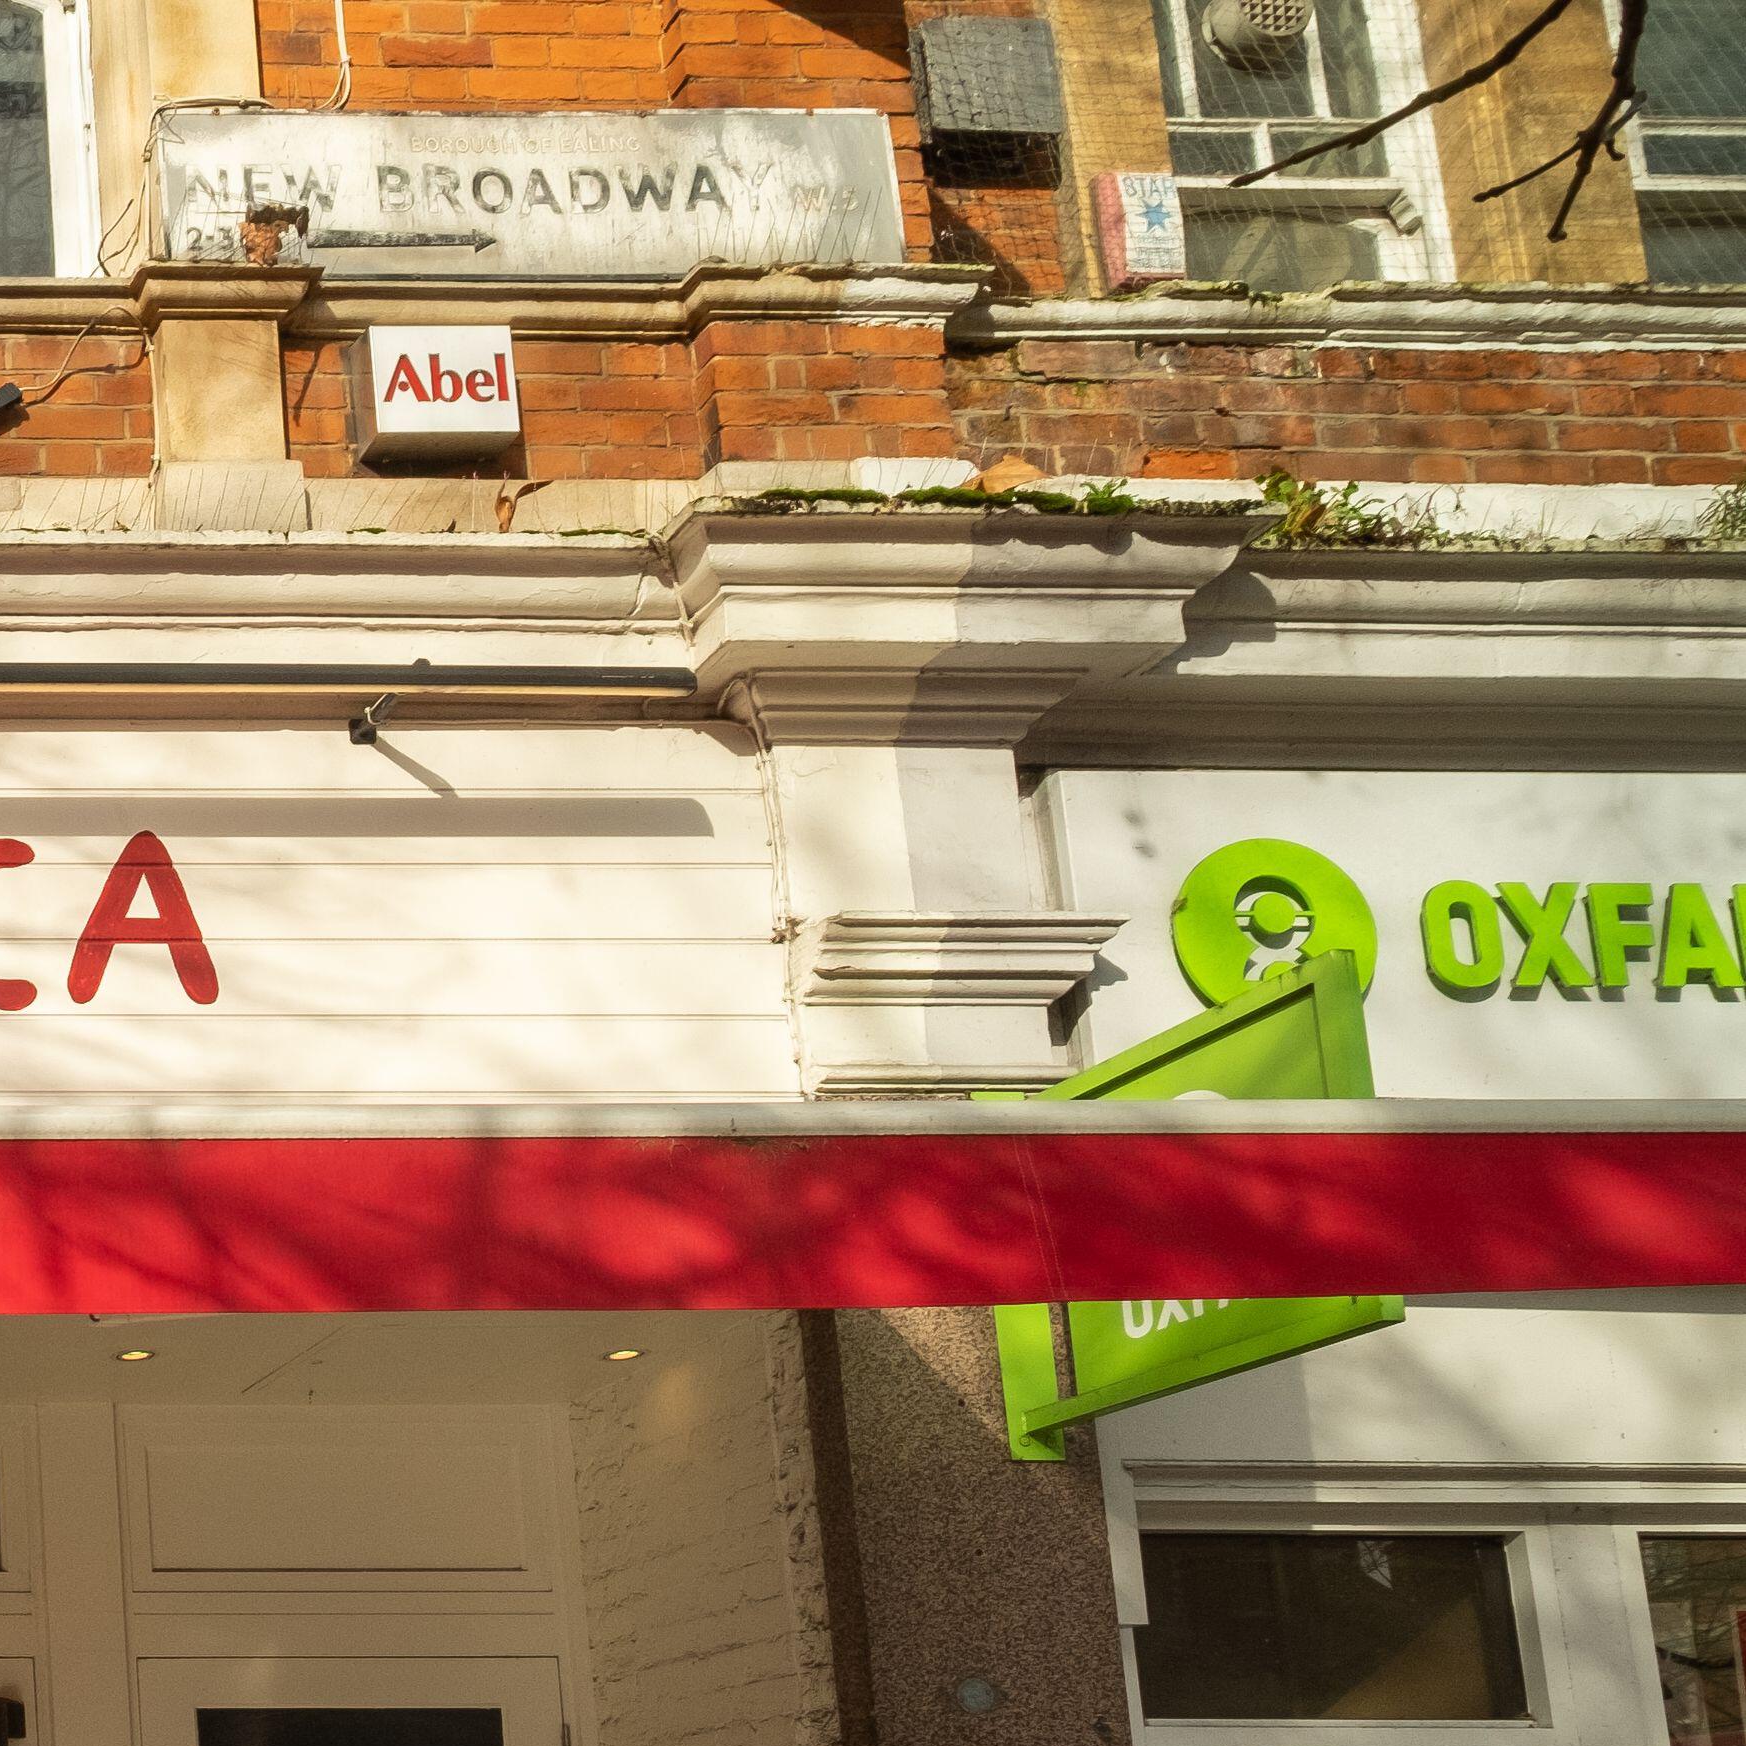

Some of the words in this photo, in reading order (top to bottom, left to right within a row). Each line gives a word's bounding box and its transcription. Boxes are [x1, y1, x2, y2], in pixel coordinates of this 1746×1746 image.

[411, 136, 518, 153] BOROUGH
[524, 137, 554, 153] OF
[560, 136, 641, 153] EALING
[186, 163, 342, 213] NEW
[377, 161, 773, 214] BROADWAY
[383, 353, 510, 403] Abel
[1420, 879, 1746, 988] OXFA
